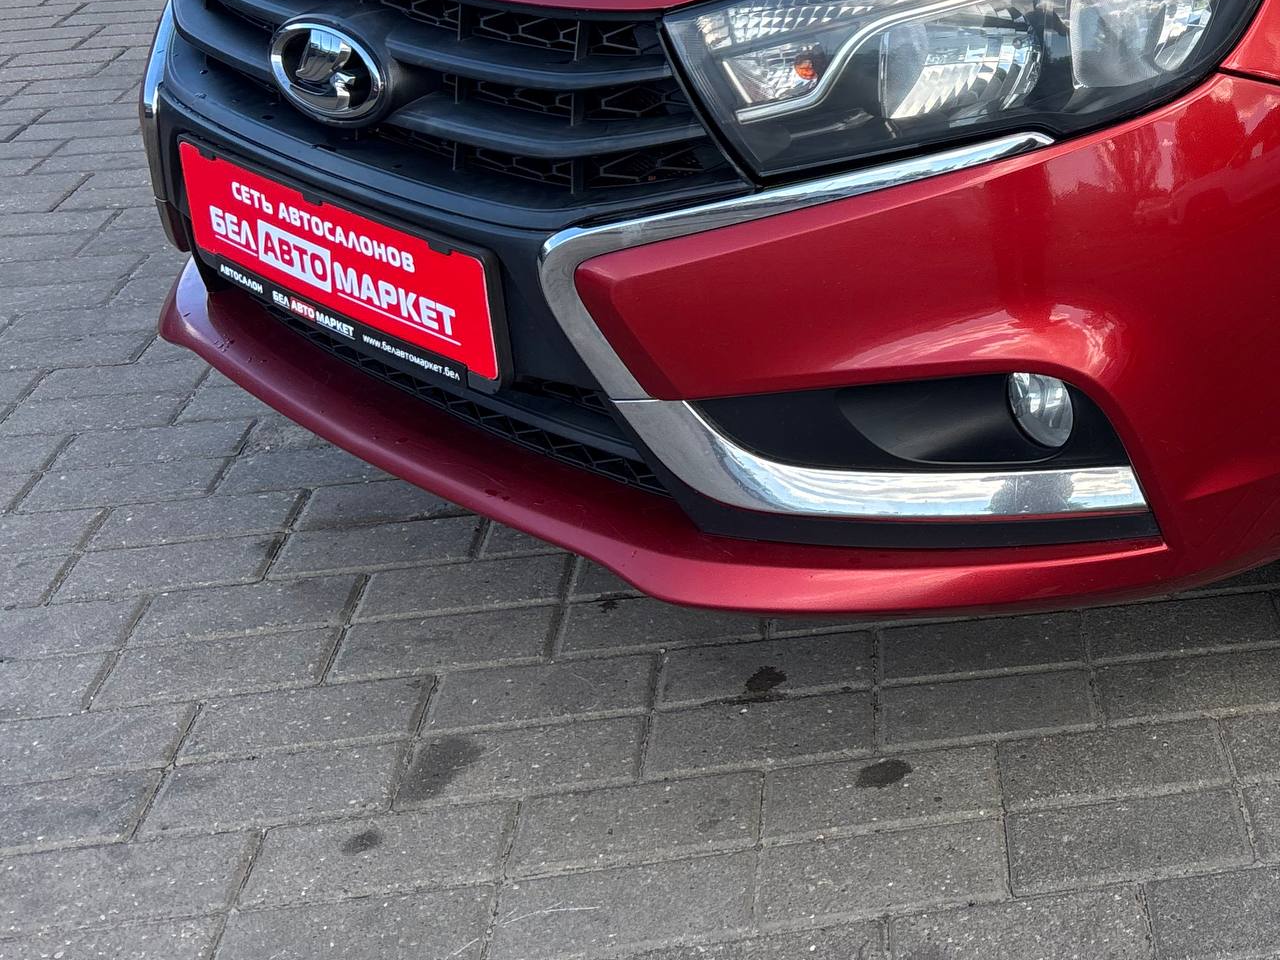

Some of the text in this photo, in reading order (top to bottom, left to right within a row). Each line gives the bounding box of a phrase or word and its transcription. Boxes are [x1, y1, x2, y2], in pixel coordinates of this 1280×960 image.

[231, 181, 416, 273] СЕТЬ АВТОСАЛОНОВ
[220, 264, 264, 294] АВТОСАЛОН
